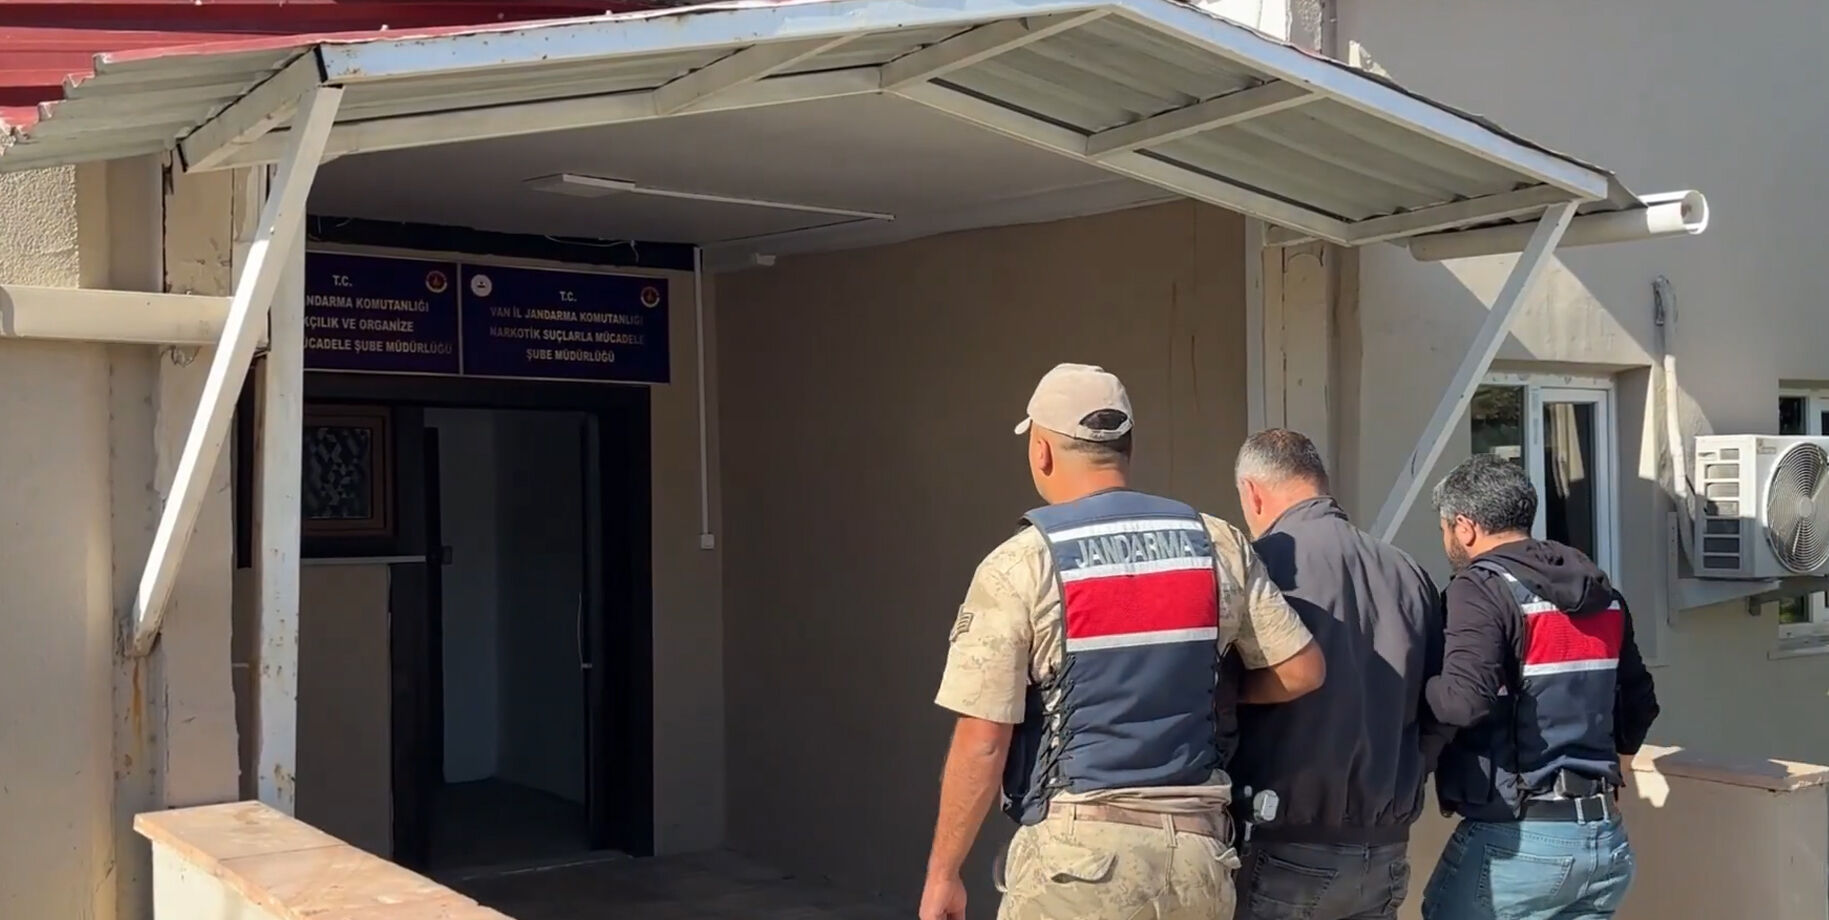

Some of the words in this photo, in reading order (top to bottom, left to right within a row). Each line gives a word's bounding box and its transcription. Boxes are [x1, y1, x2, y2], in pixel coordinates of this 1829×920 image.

[332, 275, 353, 287] T.C.
[559, 291, 577, 302] T.C.
[356, 297, 429, 312] KOMUTANLIĞI
[490, 307, 511, 318] VAN
[513, 305, 522, 318] İL
[525, 309, 578, 322] JANDARMA
[342, 318, 357, 330] VE
[359, 318, 415, 332] ORGANİZE
[490, 326, 541, 339] NARKOTİK
[543, 329, 594, 343] SUÇLARLA
[595, 331, 644, 345] MÜCADELE
[354, 339, 384, 354] ŞUBE
[526, 348, 553, 362] ŞUBE
[554, 348, 615, 363] MÜDÜRLÜĞÜ
[1075, 530, 1197, 568] JANDARMA
